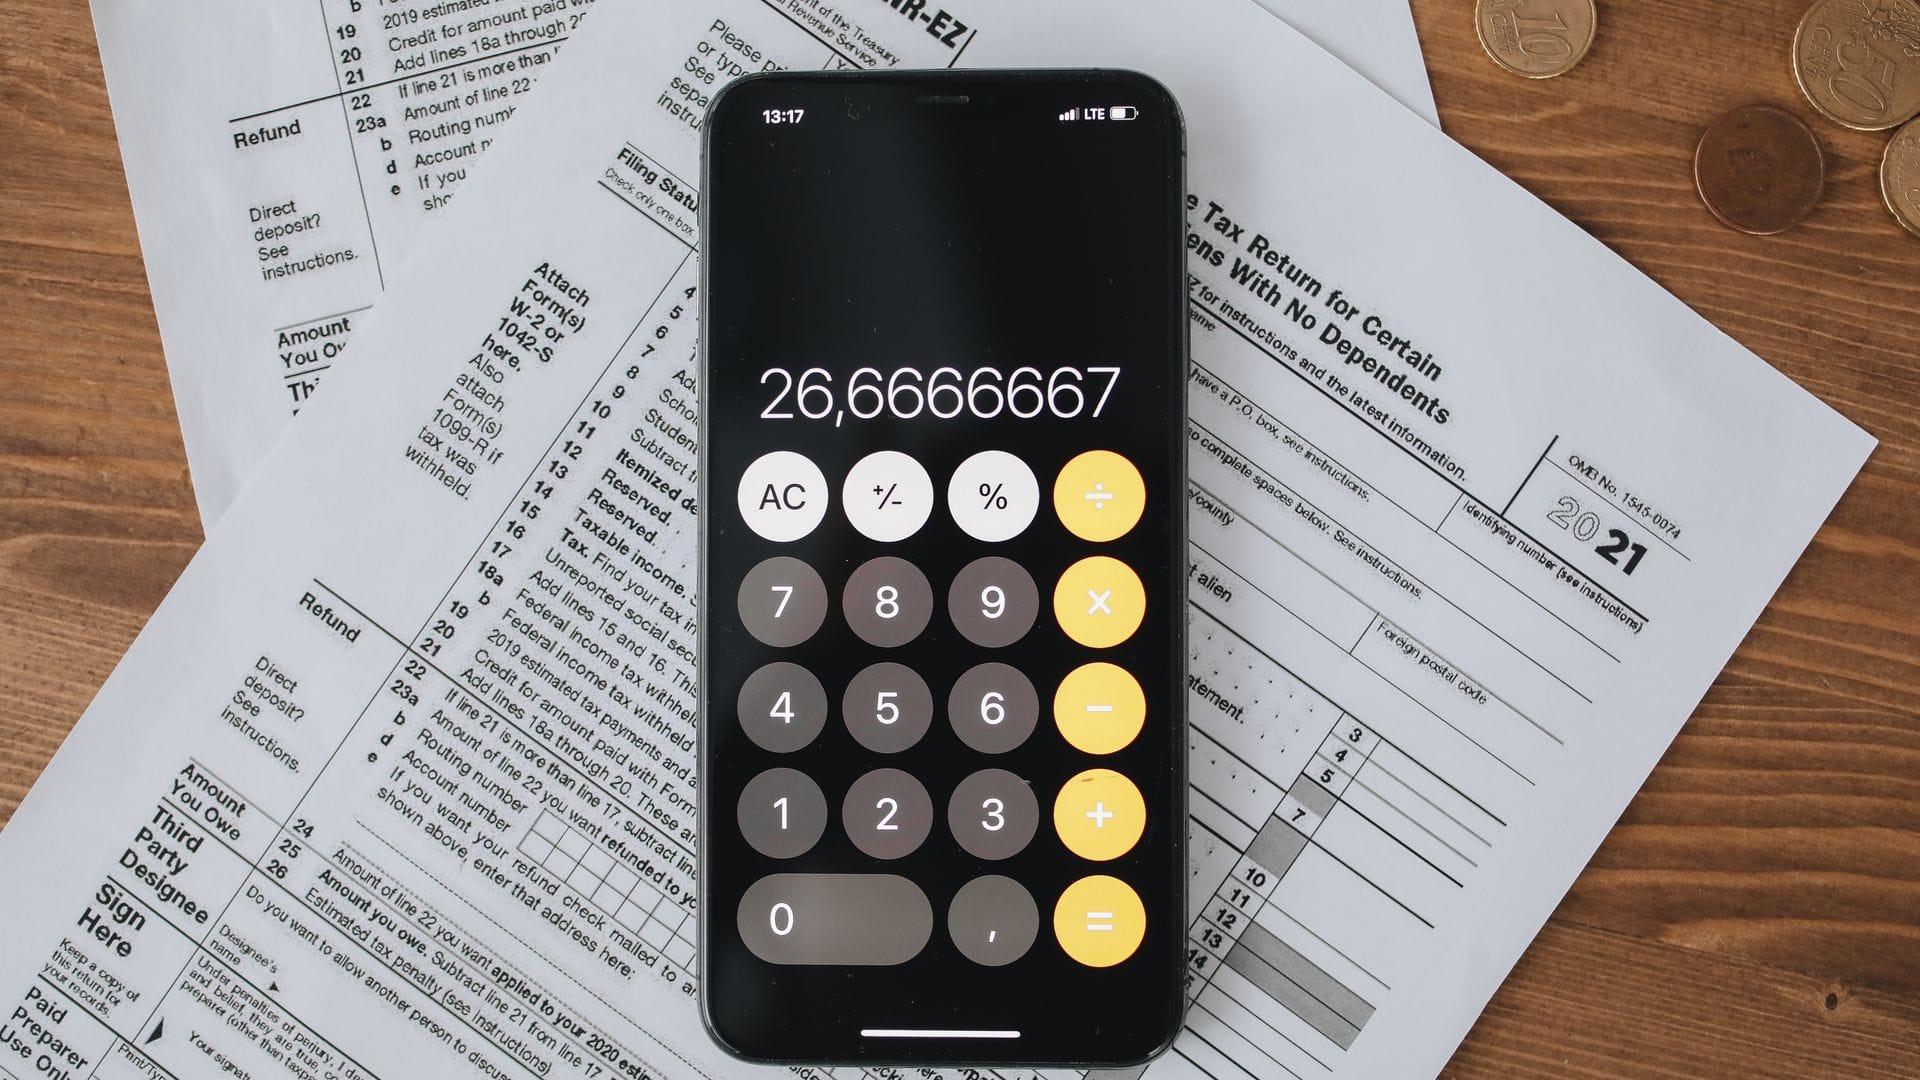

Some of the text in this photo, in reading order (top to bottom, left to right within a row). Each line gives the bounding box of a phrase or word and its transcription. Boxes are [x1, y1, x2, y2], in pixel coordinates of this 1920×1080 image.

[340, 0, 567, 64] 20 Credit for amount paid
[709, 18, 762, 63] Please
[787, 0, 877, 67] Revenue Service
[853, 26, 901, 67] Treasury
[684, 56, 715, 85] See
[355, 78, 531, 134] 23a Amount of line 22
[763, 108, 1104, 123] 13:17 LTE
[233, 118, 301, 149] Refund
[380, 120, 472, 152] b Routing
[386, 141, 477, 175] d Account
[616, 147, 698, 213] Filing Statu
[605, 167, 636, 194] Check
[635, 191, 657, 209] only
[656, 205, 675, 222] one
[521, 278, 586, 334] Form(s)
[533, 262, 590, 308] Attach
[684, 286, 697, 300] 4
[1203, 200, 1442, 382] Tax Return for Certain
[278, 317, 351, 349] Amount
[510, 296, 565, 344] W-2 or
[669, 305, 684, 320] 5
[279, 342, 346, 369] You Ow
[481, 333, 521, 372] here.
[498, 317, 554, 363] 1042-S
[1229, 256, 1450, 425] With No Dependents
[468, 352, 505, 384] Also
[612, 385, 626, 399] 9
[1197, 285, 1465, 479] for instructions and the latest information.
[442, 387, 503, 440] Form(s)
[455, 373, 505, 413] attach
[592, 400, 611, 419] 10
[761, 367, 1120, 427] 26,6666667
[417, 425, 477, 476] tax was
[432, 408, 505, 465] 1099-R if
[563, 440, 583, 461] 12
[577, 420, 596, 440] 11
[405, 445, 472, 501] withheld.
[759, 484, 805, 510] AC
[980, 484, 1007, 509] %
[1568, 455, 1681, 540] OMB No. 1545-0074
[520, 500, 683, 625] 15 Tax. Find your tax
[534, 480, 686, 599] 14 Taxable income.
[478, 560, 504, 587] 18a
[1197, 573, 1232, 603] alien
[1462, 500, 1644, 635] Identifying number (see instructions)
[299, 591, 362, 644] Refund
[772, 586, 1005, 618] 7 8 9
[255, 655, 298, 694] Direct
[477, 590, 696, 753] b Federal income tax withheld
[1376, 621, 1487, 705] Foreign postal code
[232, 690, 261, 717] See
[244, 675, 305, 722] deposit?
[770, 692, 1004, 724] 4 5 6
[220, 704, 299, 774] instructions.
[1348, 727, 1363, 743] 3
[171, 778, 241, 841] You Owe
[180, 763, 246, 818] Amount
[774, 798, 1004, 831] 1 2 3
[134, 826, 189, 876] Party
[152, 804, 205, 854] Third
[118, 848, 209, 924] Designee
[278, 838, 427, 957] 25 Amount you owe.
[377, 787, 636, 981] shown above, enter that address here:
[1245, 868, 1266, 888] 10
[95, 883, 146, 932] Sign
[266, 859, 443, 996] 26 Estimated tax penalty
[770, 903, 793, 935] 0
[77, 906, 132, 958] Here
[209, 939, 241, 966] name
[41, 962, 110, 1019] your records.
[52, 950, 121, 1007] this return for
[59, 937, 141, 1003] Keep a copy of
[24, 985, 68, 1025] Paid
[0, 1024, 32, 1059] Use
[10, 1005, 89, 1070] Preparer
